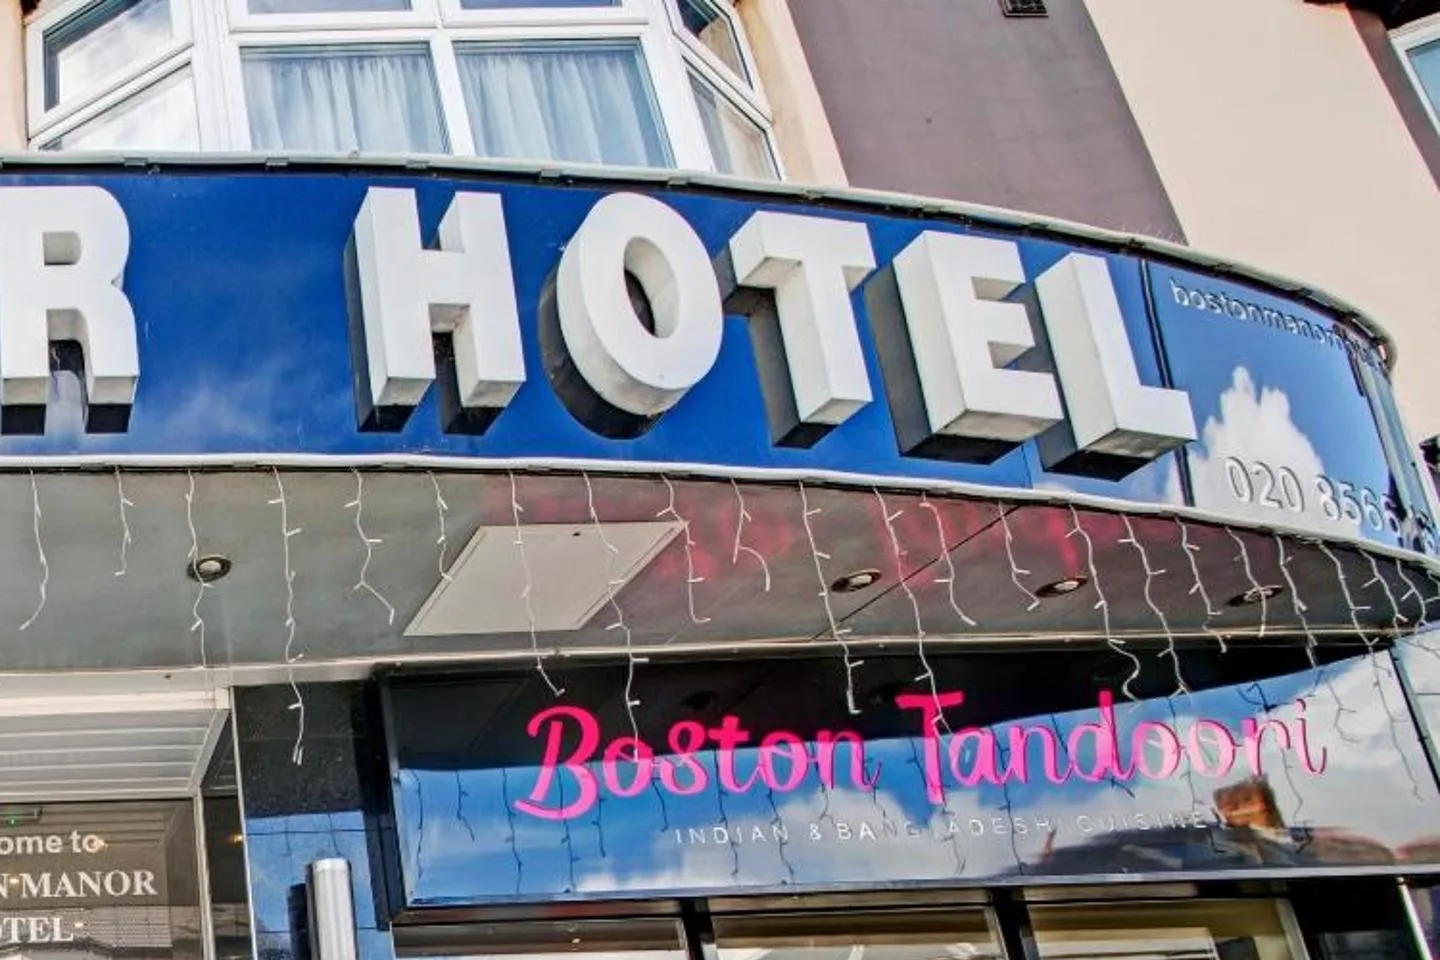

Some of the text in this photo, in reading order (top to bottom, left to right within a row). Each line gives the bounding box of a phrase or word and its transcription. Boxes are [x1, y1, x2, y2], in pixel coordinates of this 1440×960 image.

[353, 185, 1197, 460] HOTEL
[1225, 456, 1304, 513] 020
[514, 688, 1327, 821] Boston Tandoori
[70, 829, 102, 855] to
[675, 808, 1209, 845] INDIAN & BANGADESHI CUISINE
[20, 869, 158, 900] MANOR
